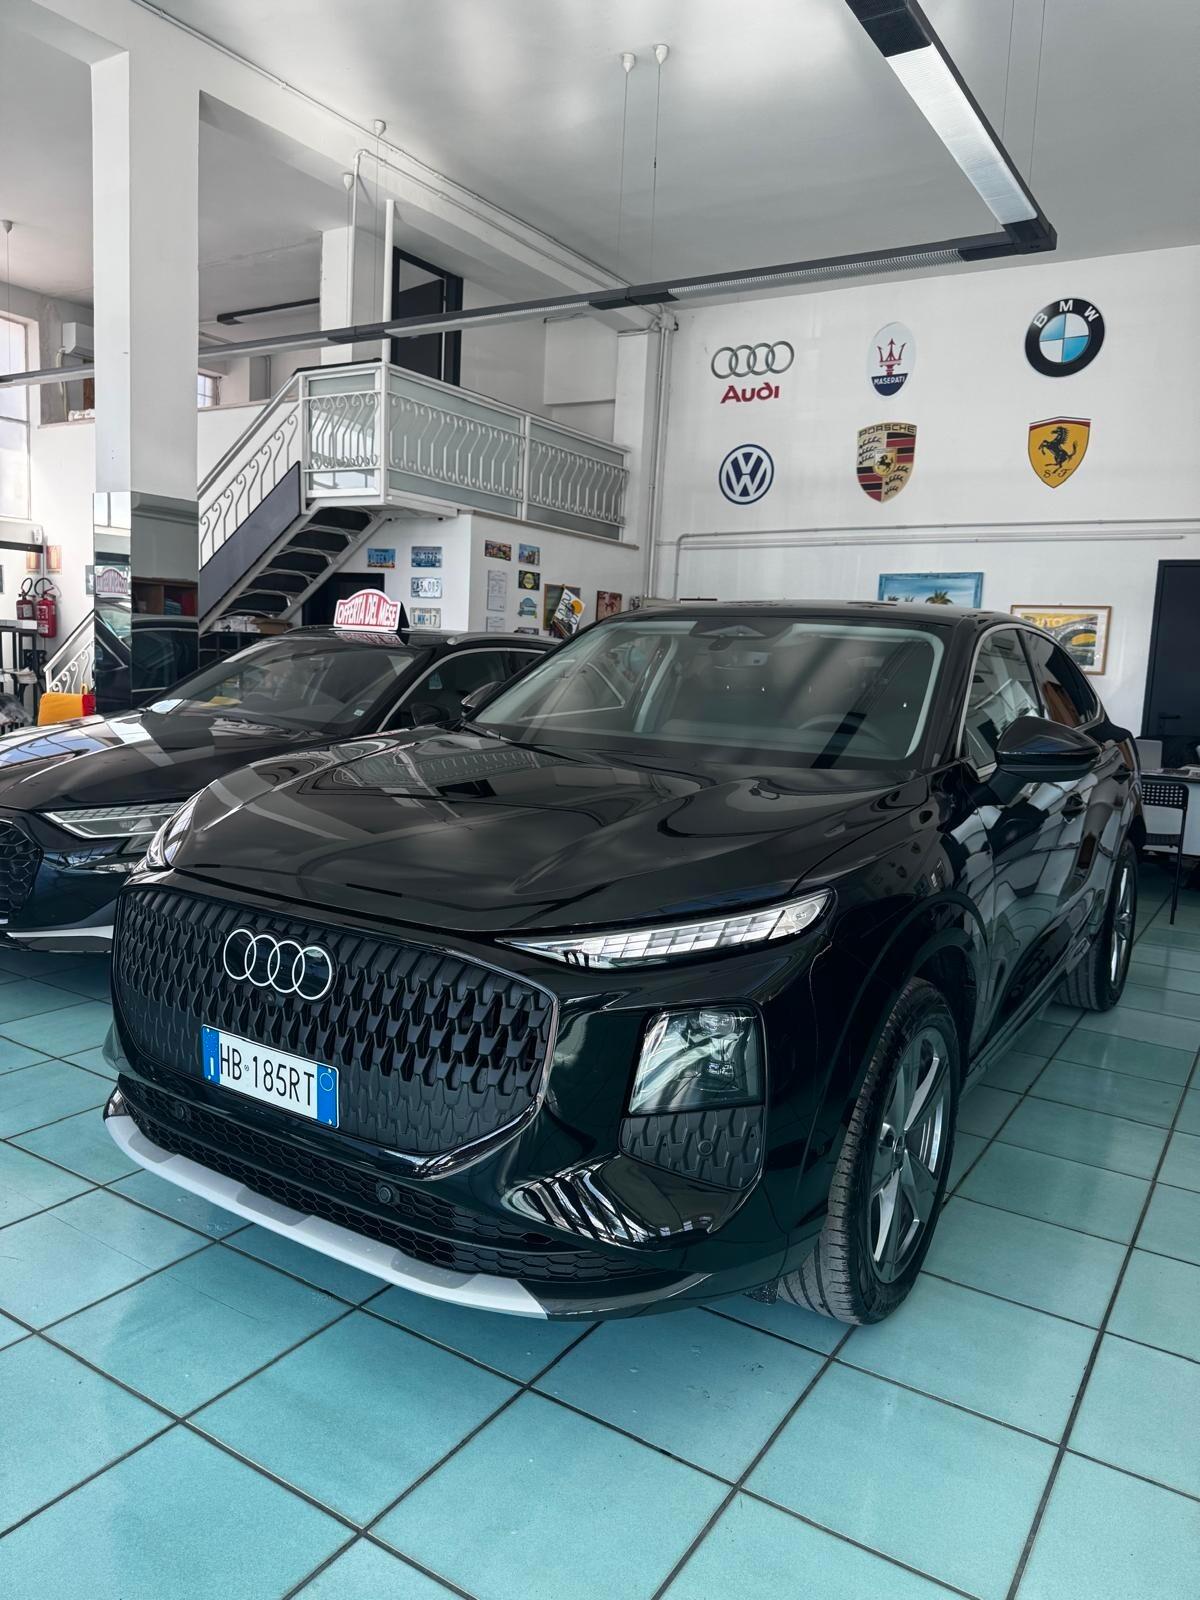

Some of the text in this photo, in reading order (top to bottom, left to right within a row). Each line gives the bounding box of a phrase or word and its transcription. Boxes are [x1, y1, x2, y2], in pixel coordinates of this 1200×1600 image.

[1033, 300, 1099, 328] BMW
[720, 382, 780, 404] Audi
[873, 376, 905, 386] MASERATI
[858, 423, 916, 438] PORSCHE
[337, 593, 397, 626] OFFERTA DEL MESE
[219, 1042, 315, 1106] HB 185RT
